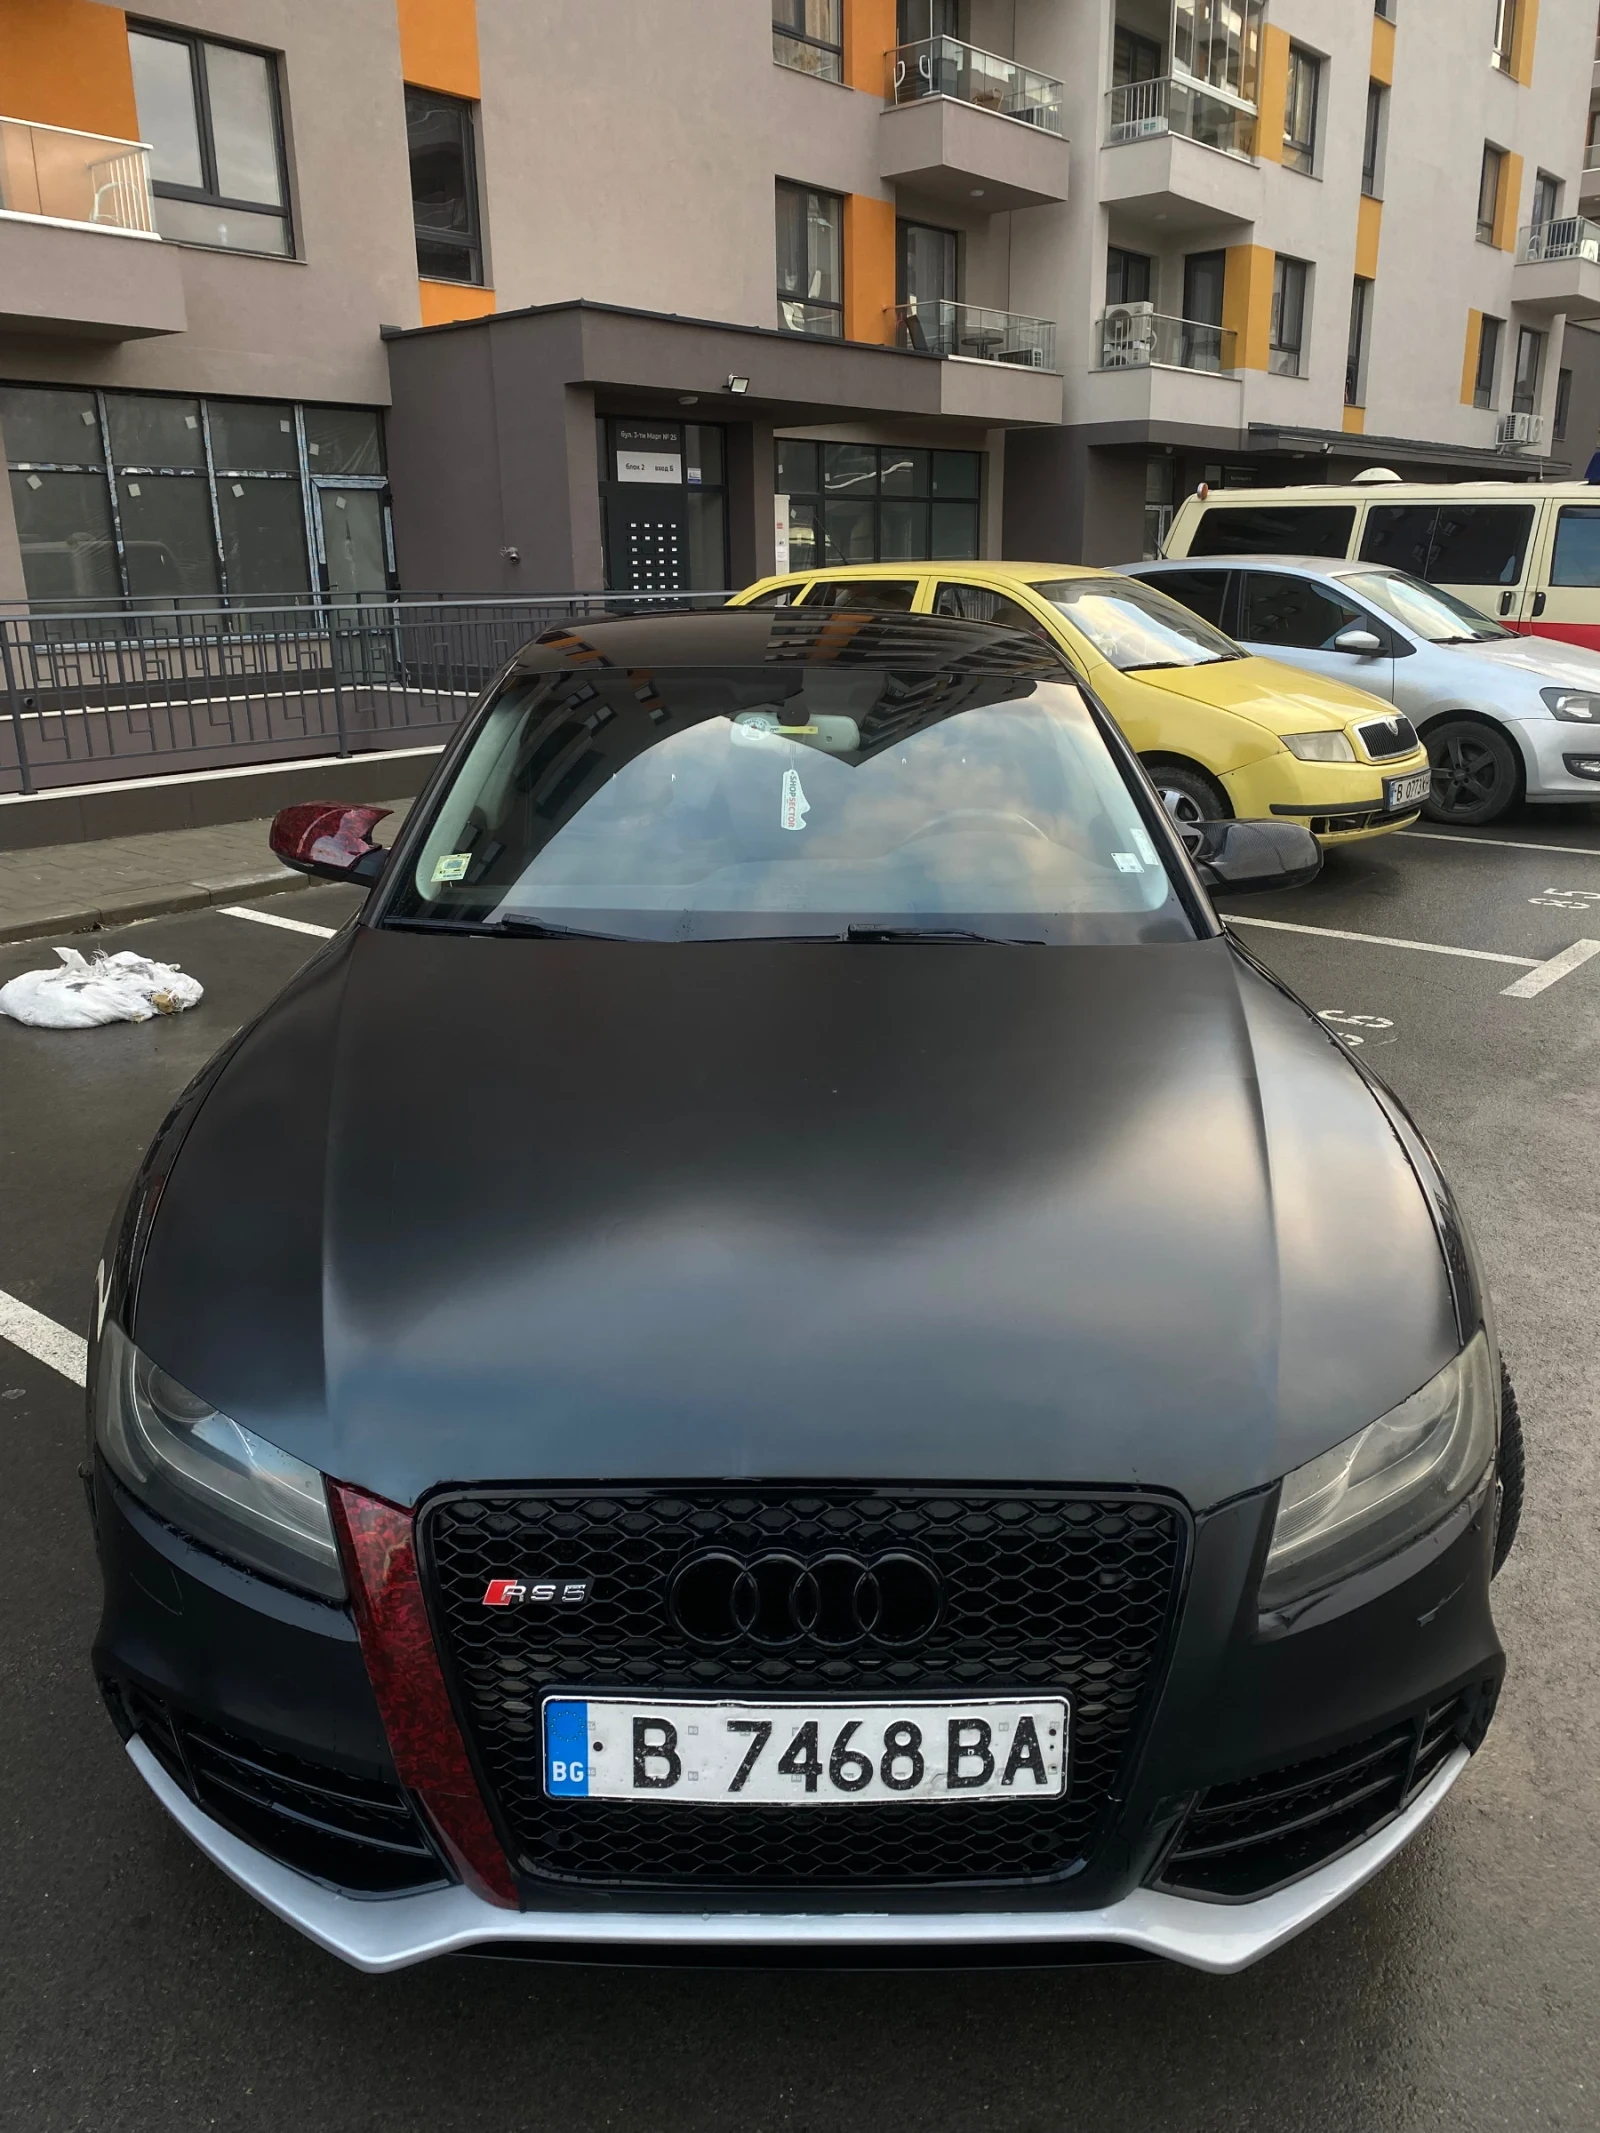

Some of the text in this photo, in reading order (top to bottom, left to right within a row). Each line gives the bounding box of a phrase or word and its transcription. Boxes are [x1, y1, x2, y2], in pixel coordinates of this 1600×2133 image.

[646, 432, 662, 441] Март
[625, 463, 640, 471] блок
[1397, 784, 1403, 801] B
[788, 775, 797, 828] SHOPSECTOR
[552, 1715, 1048, 1793] BG B 7468 BA
